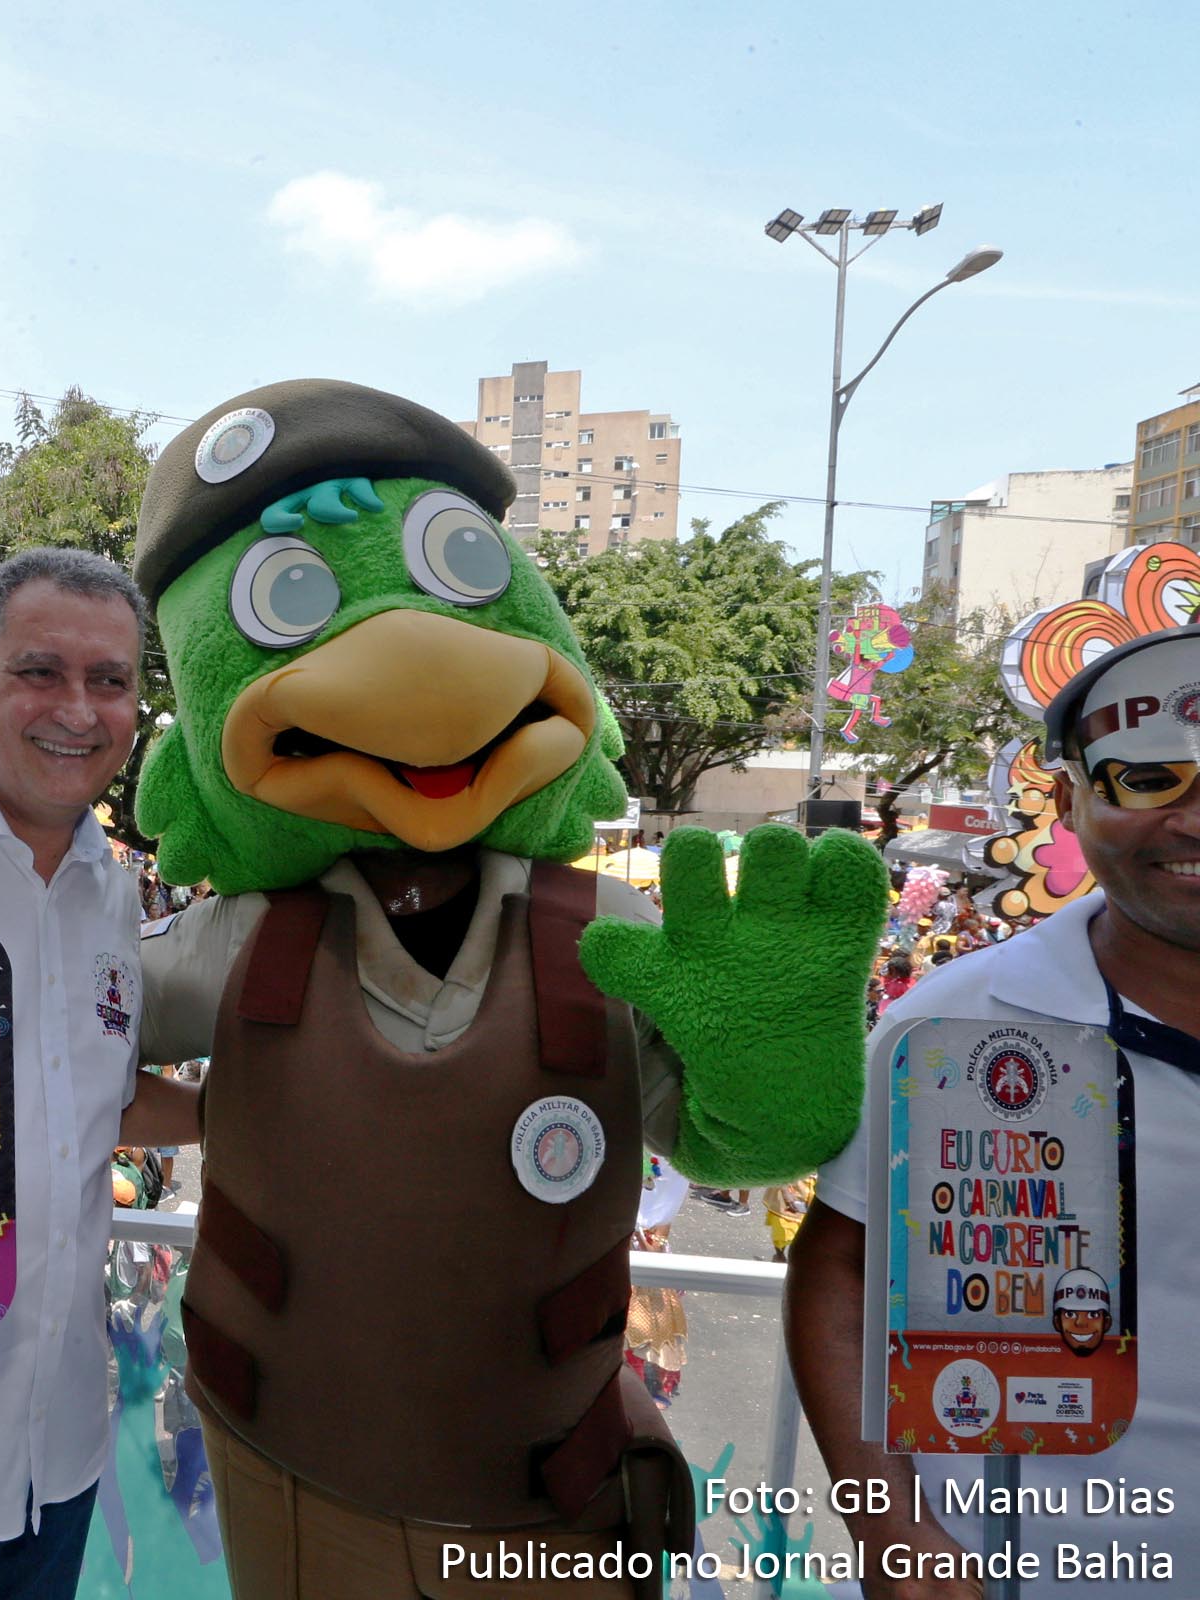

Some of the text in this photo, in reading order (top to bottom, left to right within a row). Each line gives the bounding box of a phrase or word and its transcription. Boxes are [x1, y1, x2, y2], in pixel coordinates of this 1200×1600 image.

[1125, 695, 1161, 730] P
[966, 1028, 1058, 1085] POLÍCIA MILITAR DA BAHIA
[539, 1101, 580, 1113] MILITAR
[581, 1110, 593, 1124] DA
[591, 1124, 604, 1158] BAHIA
[940, 1128, 1064, 1175] EU CURTO
[931, 1178, 1076, 1220] O CARNAVAL
[929, 1220, 1091, 1269] NA CORRENTE
[946, 1269, 1045, 1316] DO BEM
[912, 1343, 974, 1353] www.pm.ba.gov.br
